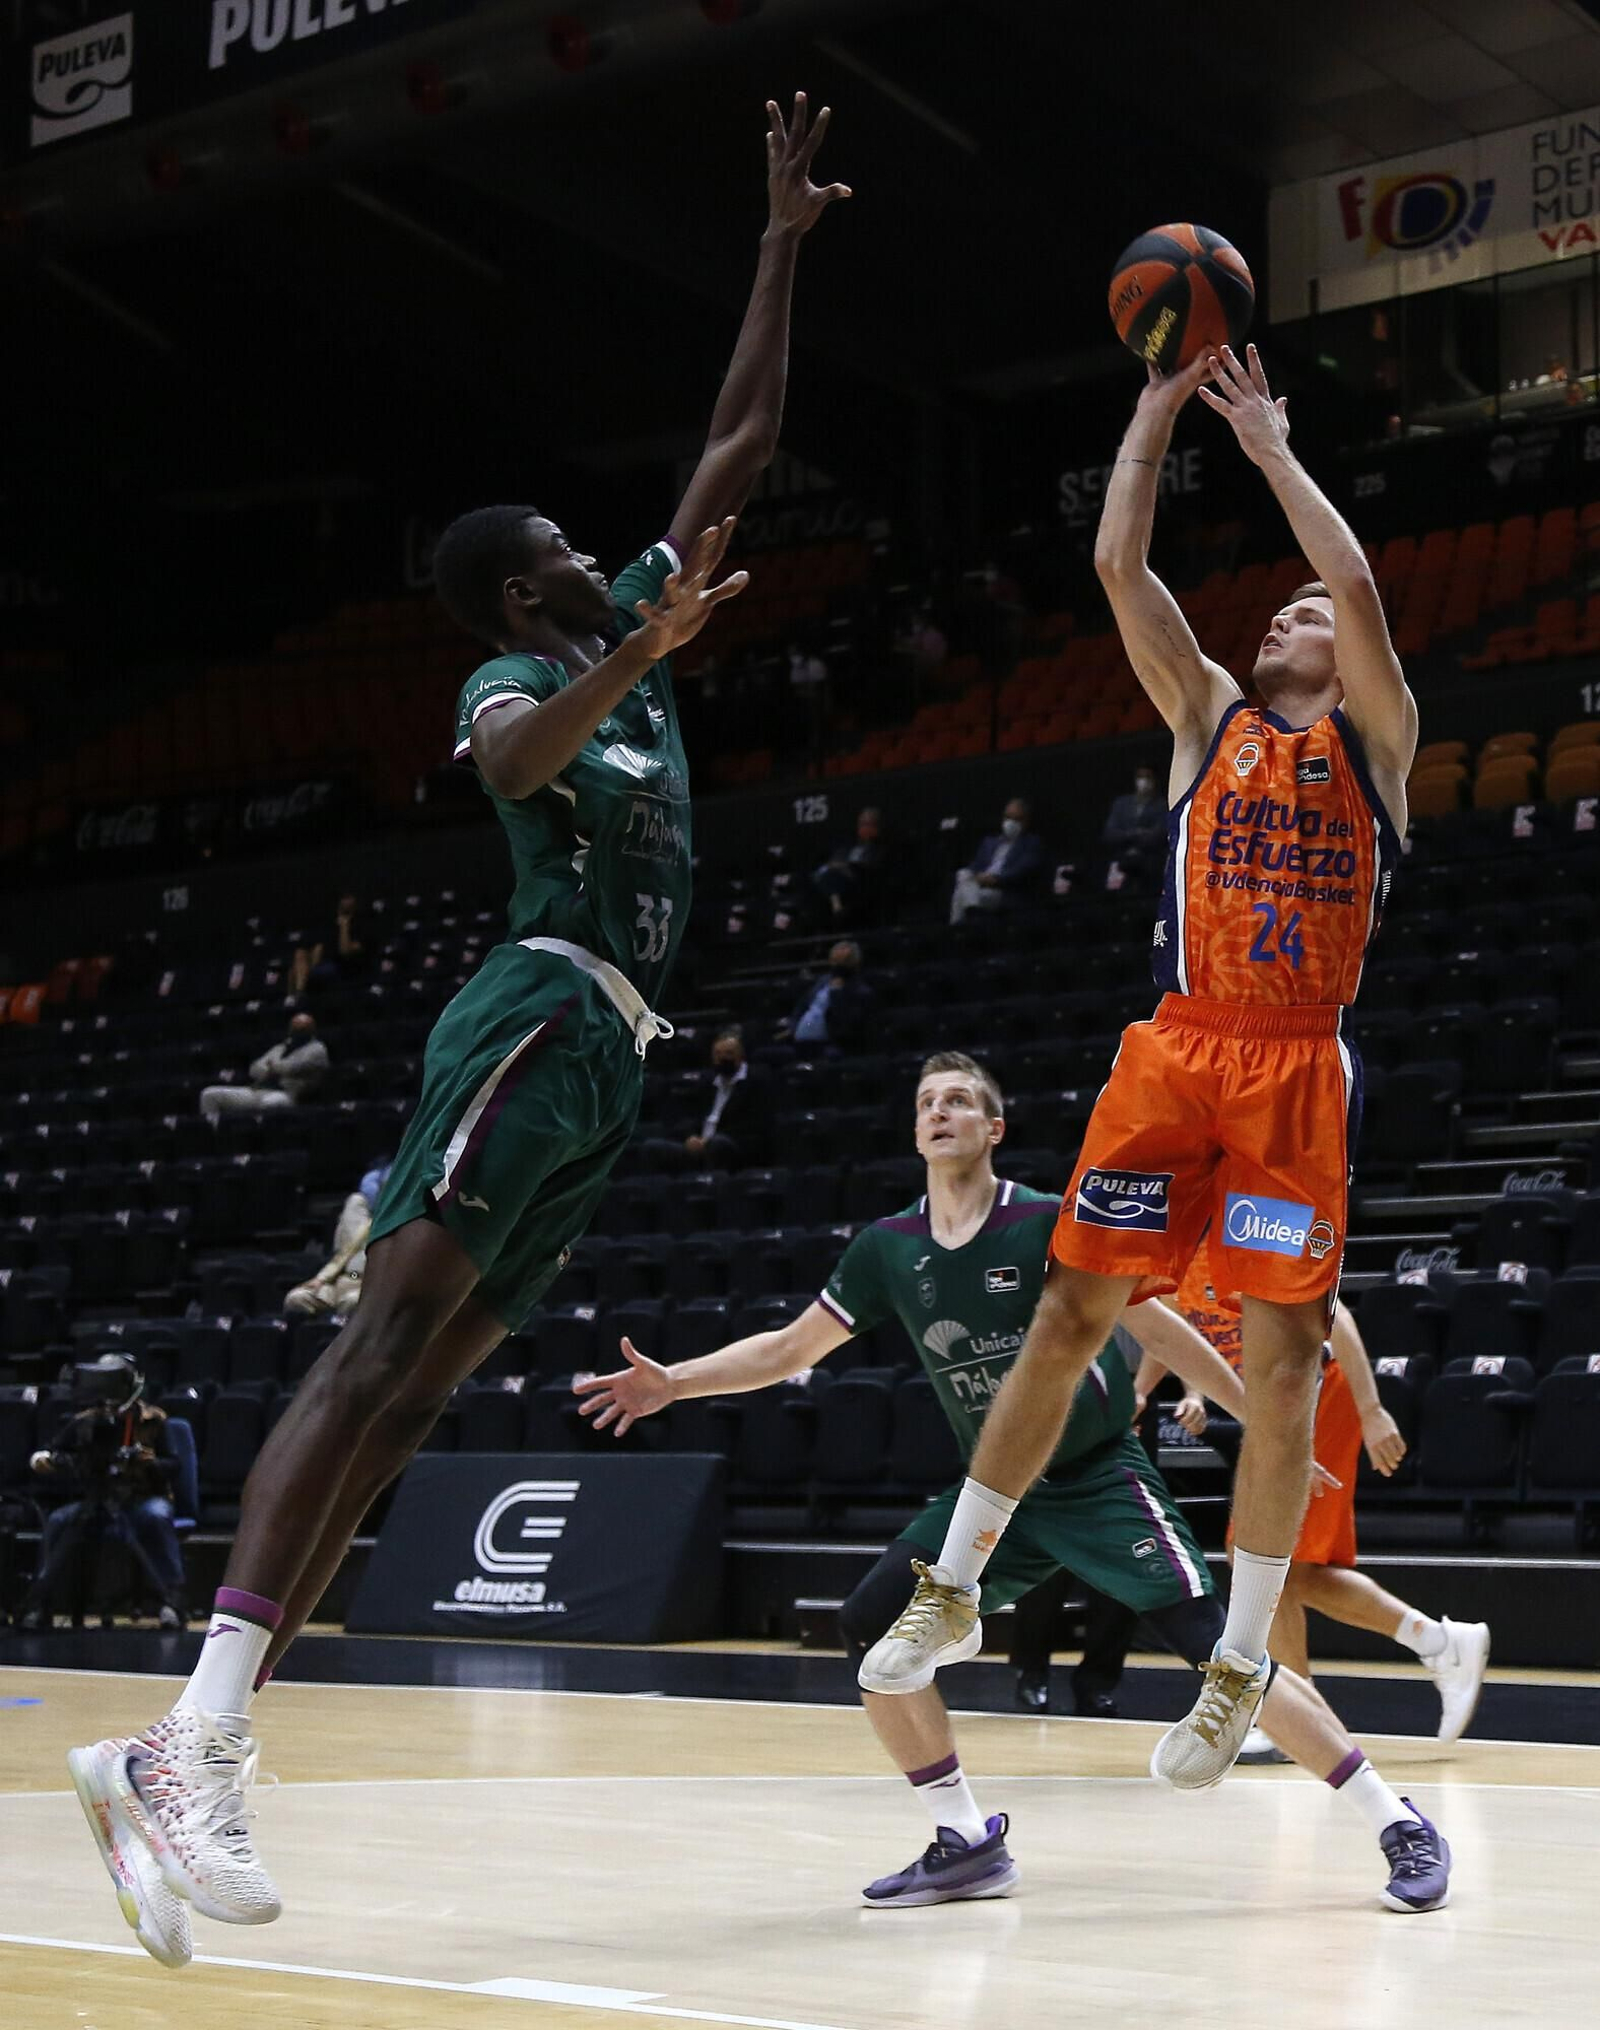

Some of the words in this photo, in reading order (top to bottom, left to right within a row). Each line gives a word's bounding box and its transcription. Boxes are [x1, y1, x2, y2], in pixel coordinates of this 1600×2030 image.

[37, 31, 127, 84] PULEVA
[208, 0, 402, 71] PUL
[1533, 187, 1600, 229] MU
[1058, 447, 1202, 516] SERE
[793, 794, 829, 824] 125
[1216, 790, 1321, 837] Cultua
[1326, 817, 1353, 838] del
[1208, 828, 1356, 879] Esfuerzo
[633, 893, 673, 963] 33
[1250, 902, 1305, 971] 24
[1086, 1174, 1166, 1197] PULEVA
[1229, 1203, 1307, 1247] Midea
[454, 1576, 546, 1603] elmusa
